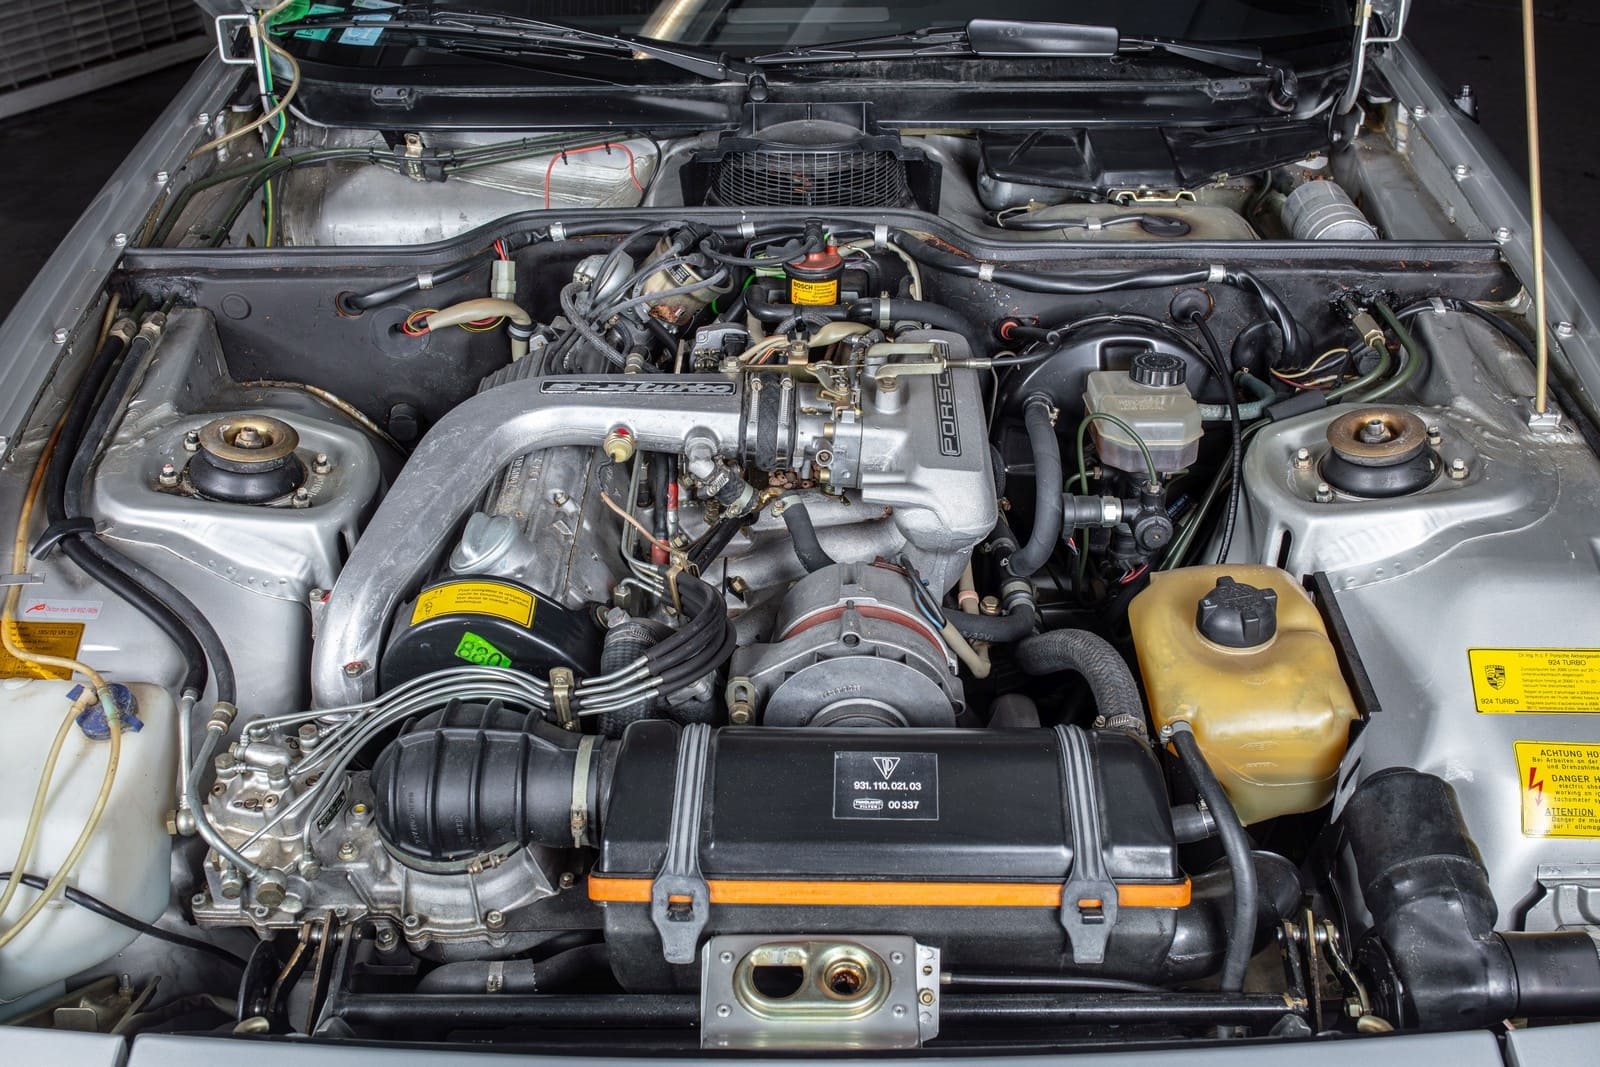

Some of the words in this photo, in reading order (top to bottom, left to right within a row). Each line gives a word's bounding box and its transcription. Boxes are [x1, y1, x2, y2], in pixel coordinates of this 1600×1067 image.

[793, 281, 813, 290] BOSCH
[636, 381, 731, 393] turbo
[937, 368, 957, 454] PORSC
[1540, 749, 1583, 758] ACHTUNG
[1552, 774, 1590, 783] DANGER
